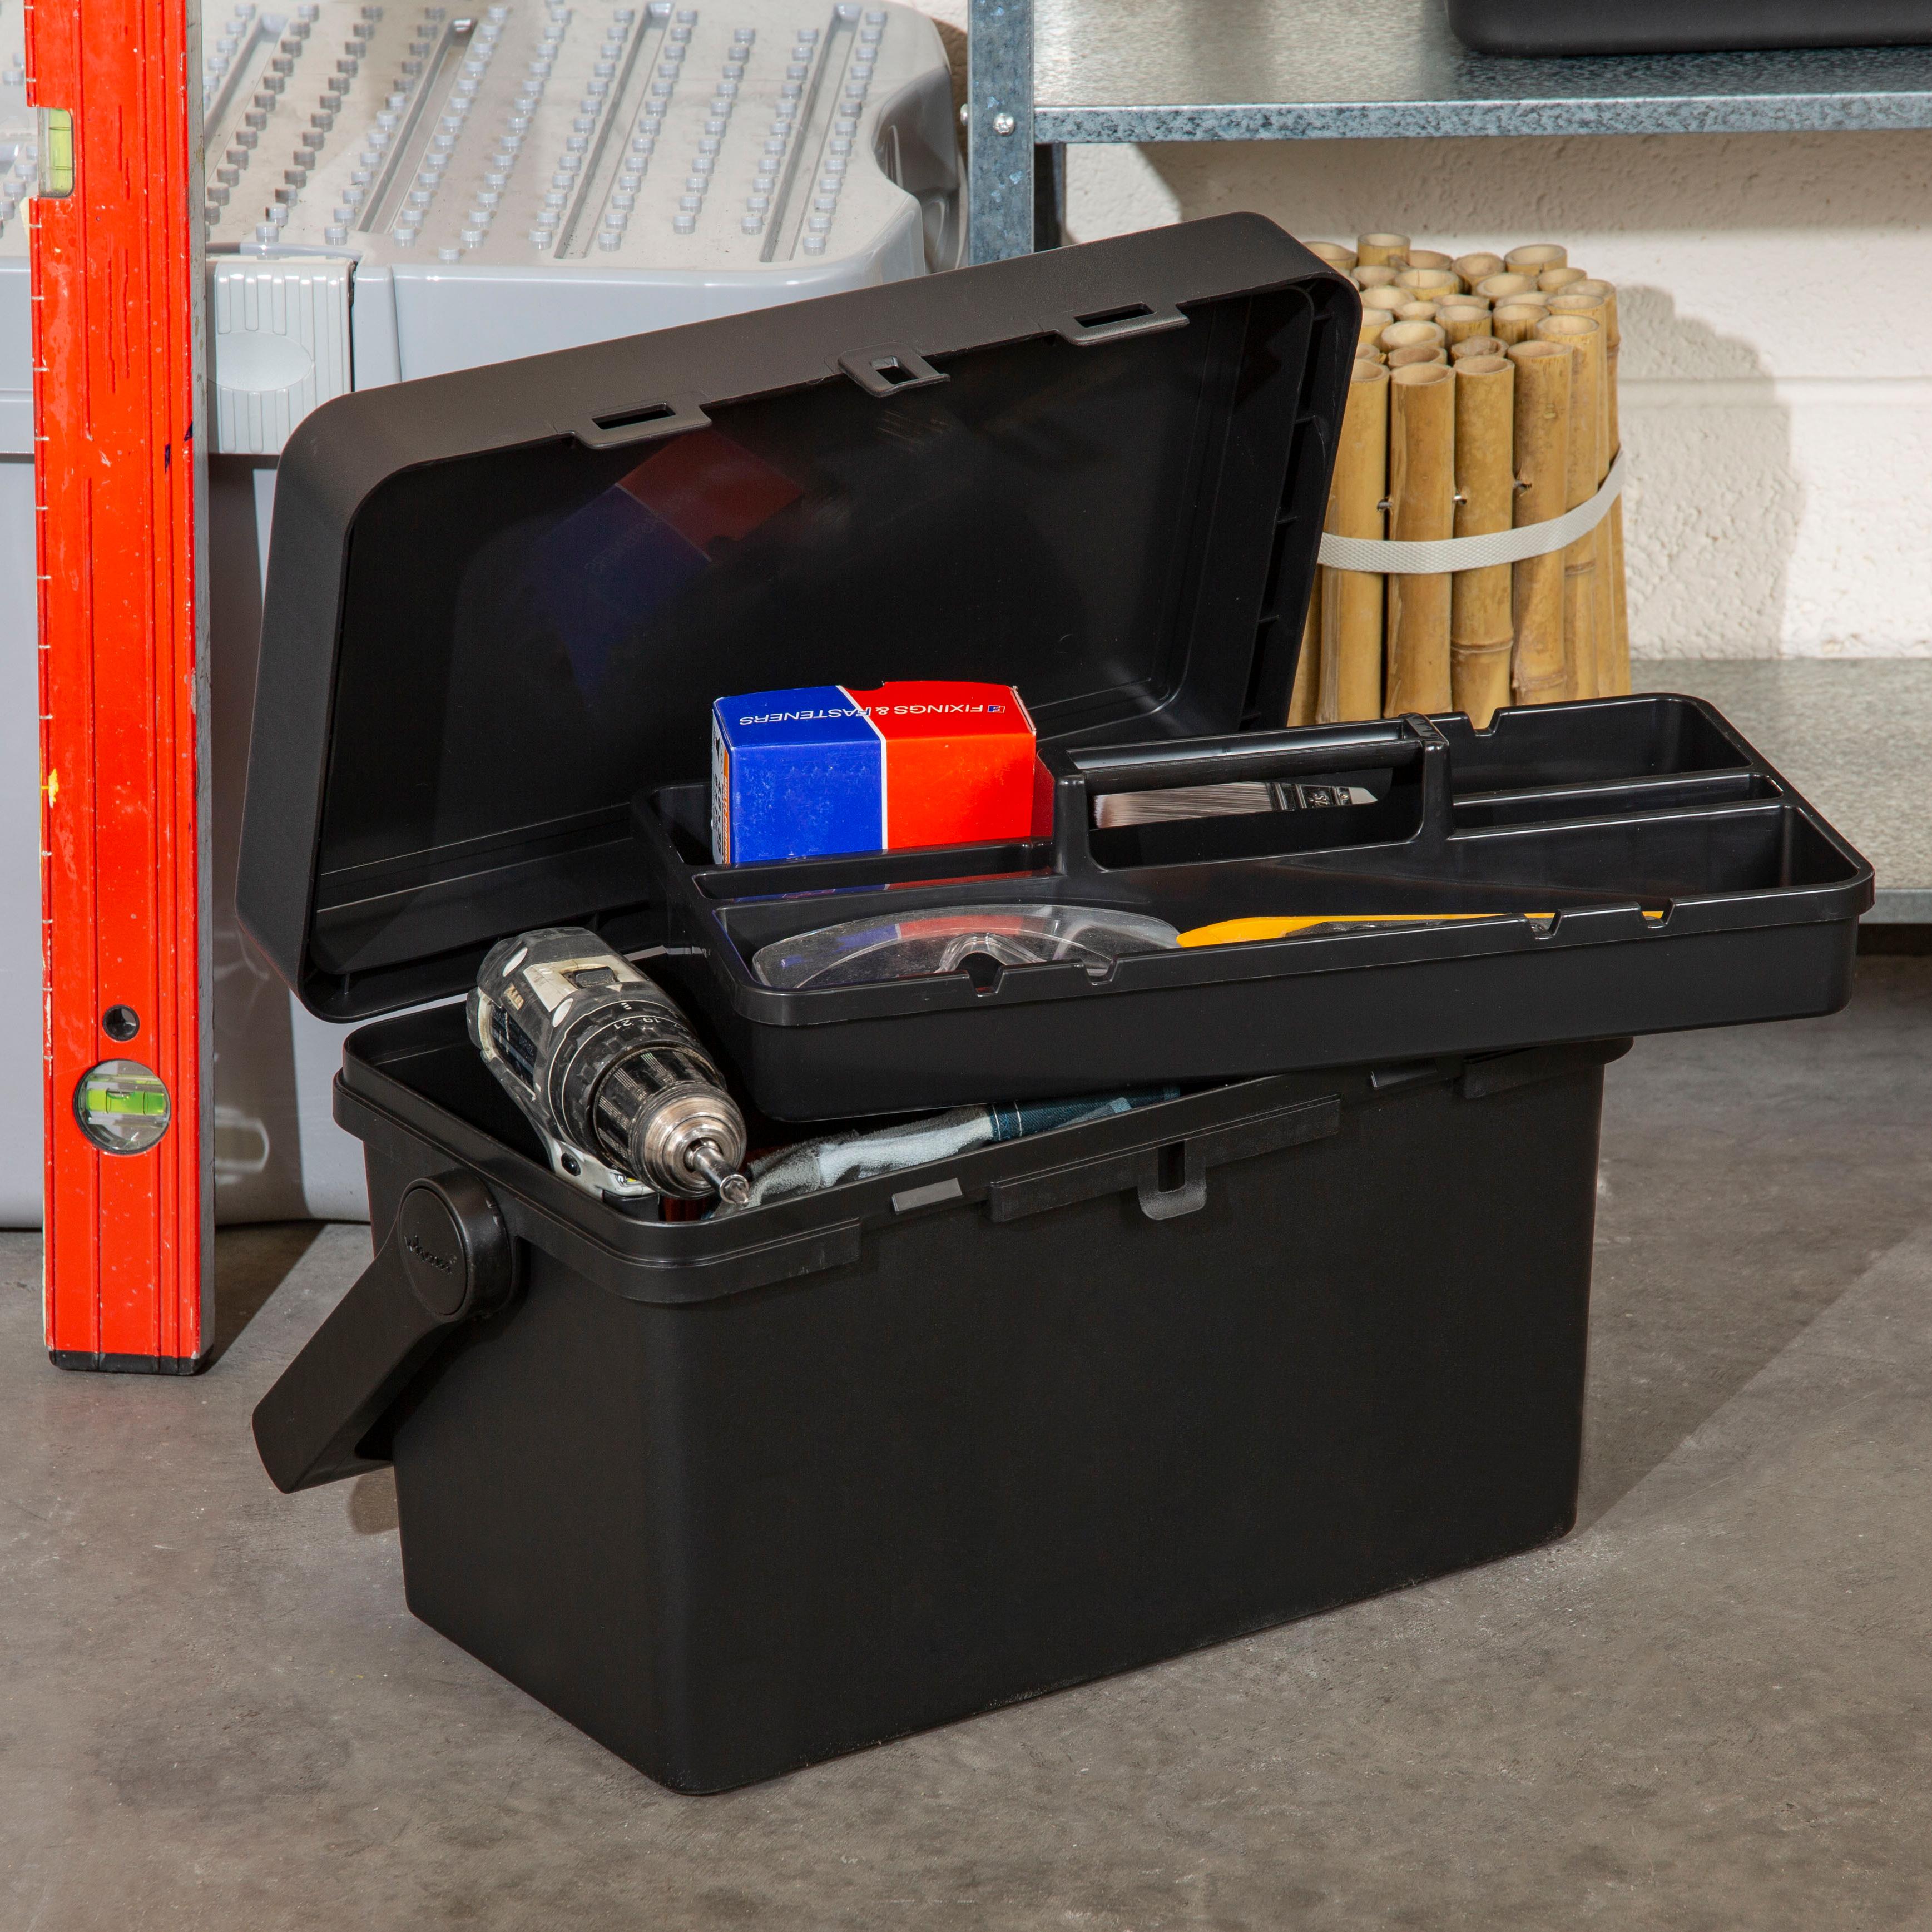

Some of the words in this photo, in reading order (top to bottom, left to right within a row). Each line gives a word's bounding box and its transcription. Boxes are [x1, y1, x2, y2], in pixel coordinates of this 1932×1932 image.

[875, 706, 889, 716] &
[894, 704, 983, 715] FIXINGS
[740, 706, 871, 725] FASTENERS
[613, 1019, 632, 1029] 21
